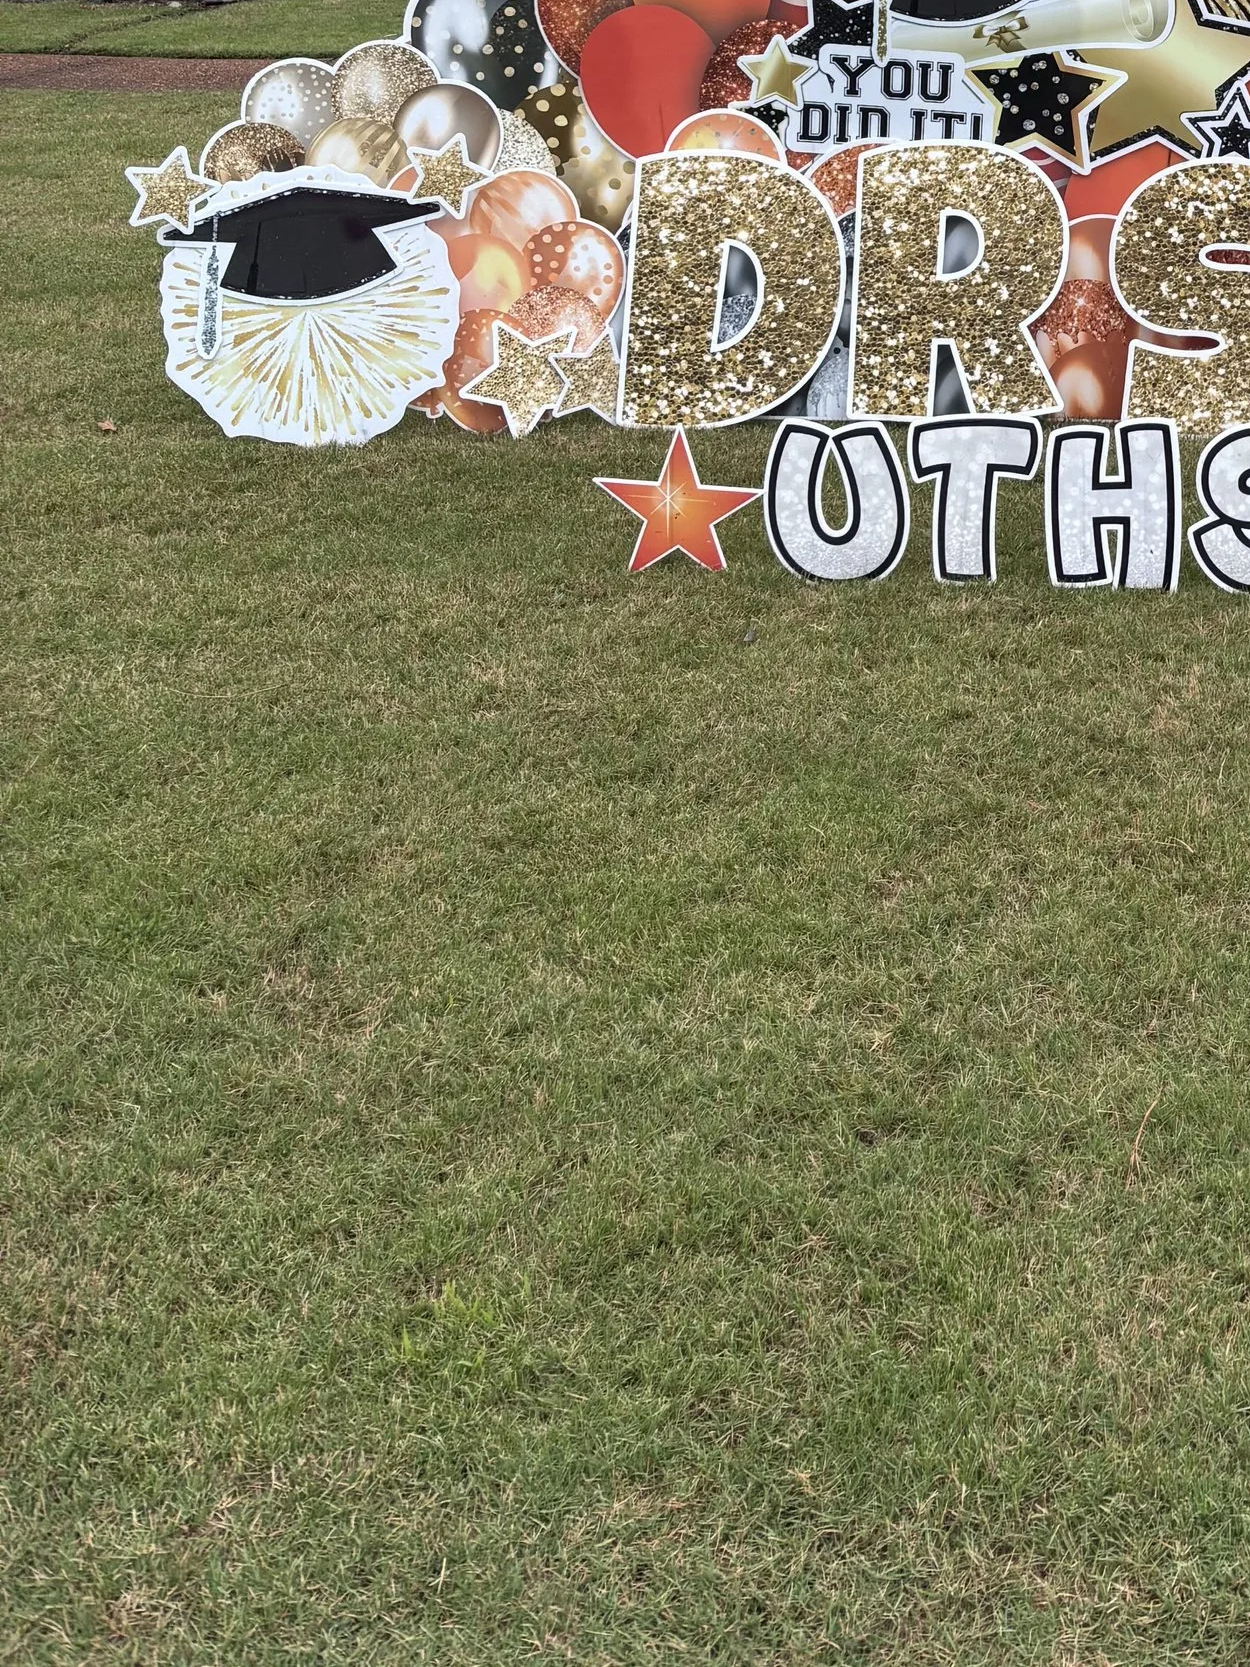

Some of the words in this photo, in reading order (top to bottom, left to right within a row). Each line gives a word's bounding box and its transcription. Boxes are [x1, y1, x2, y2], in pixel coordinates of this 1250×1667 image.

[829, 53, 955, 103] YOU
[797, 101, 890, 144] DID
[616, 138, 1069, 429] DR
